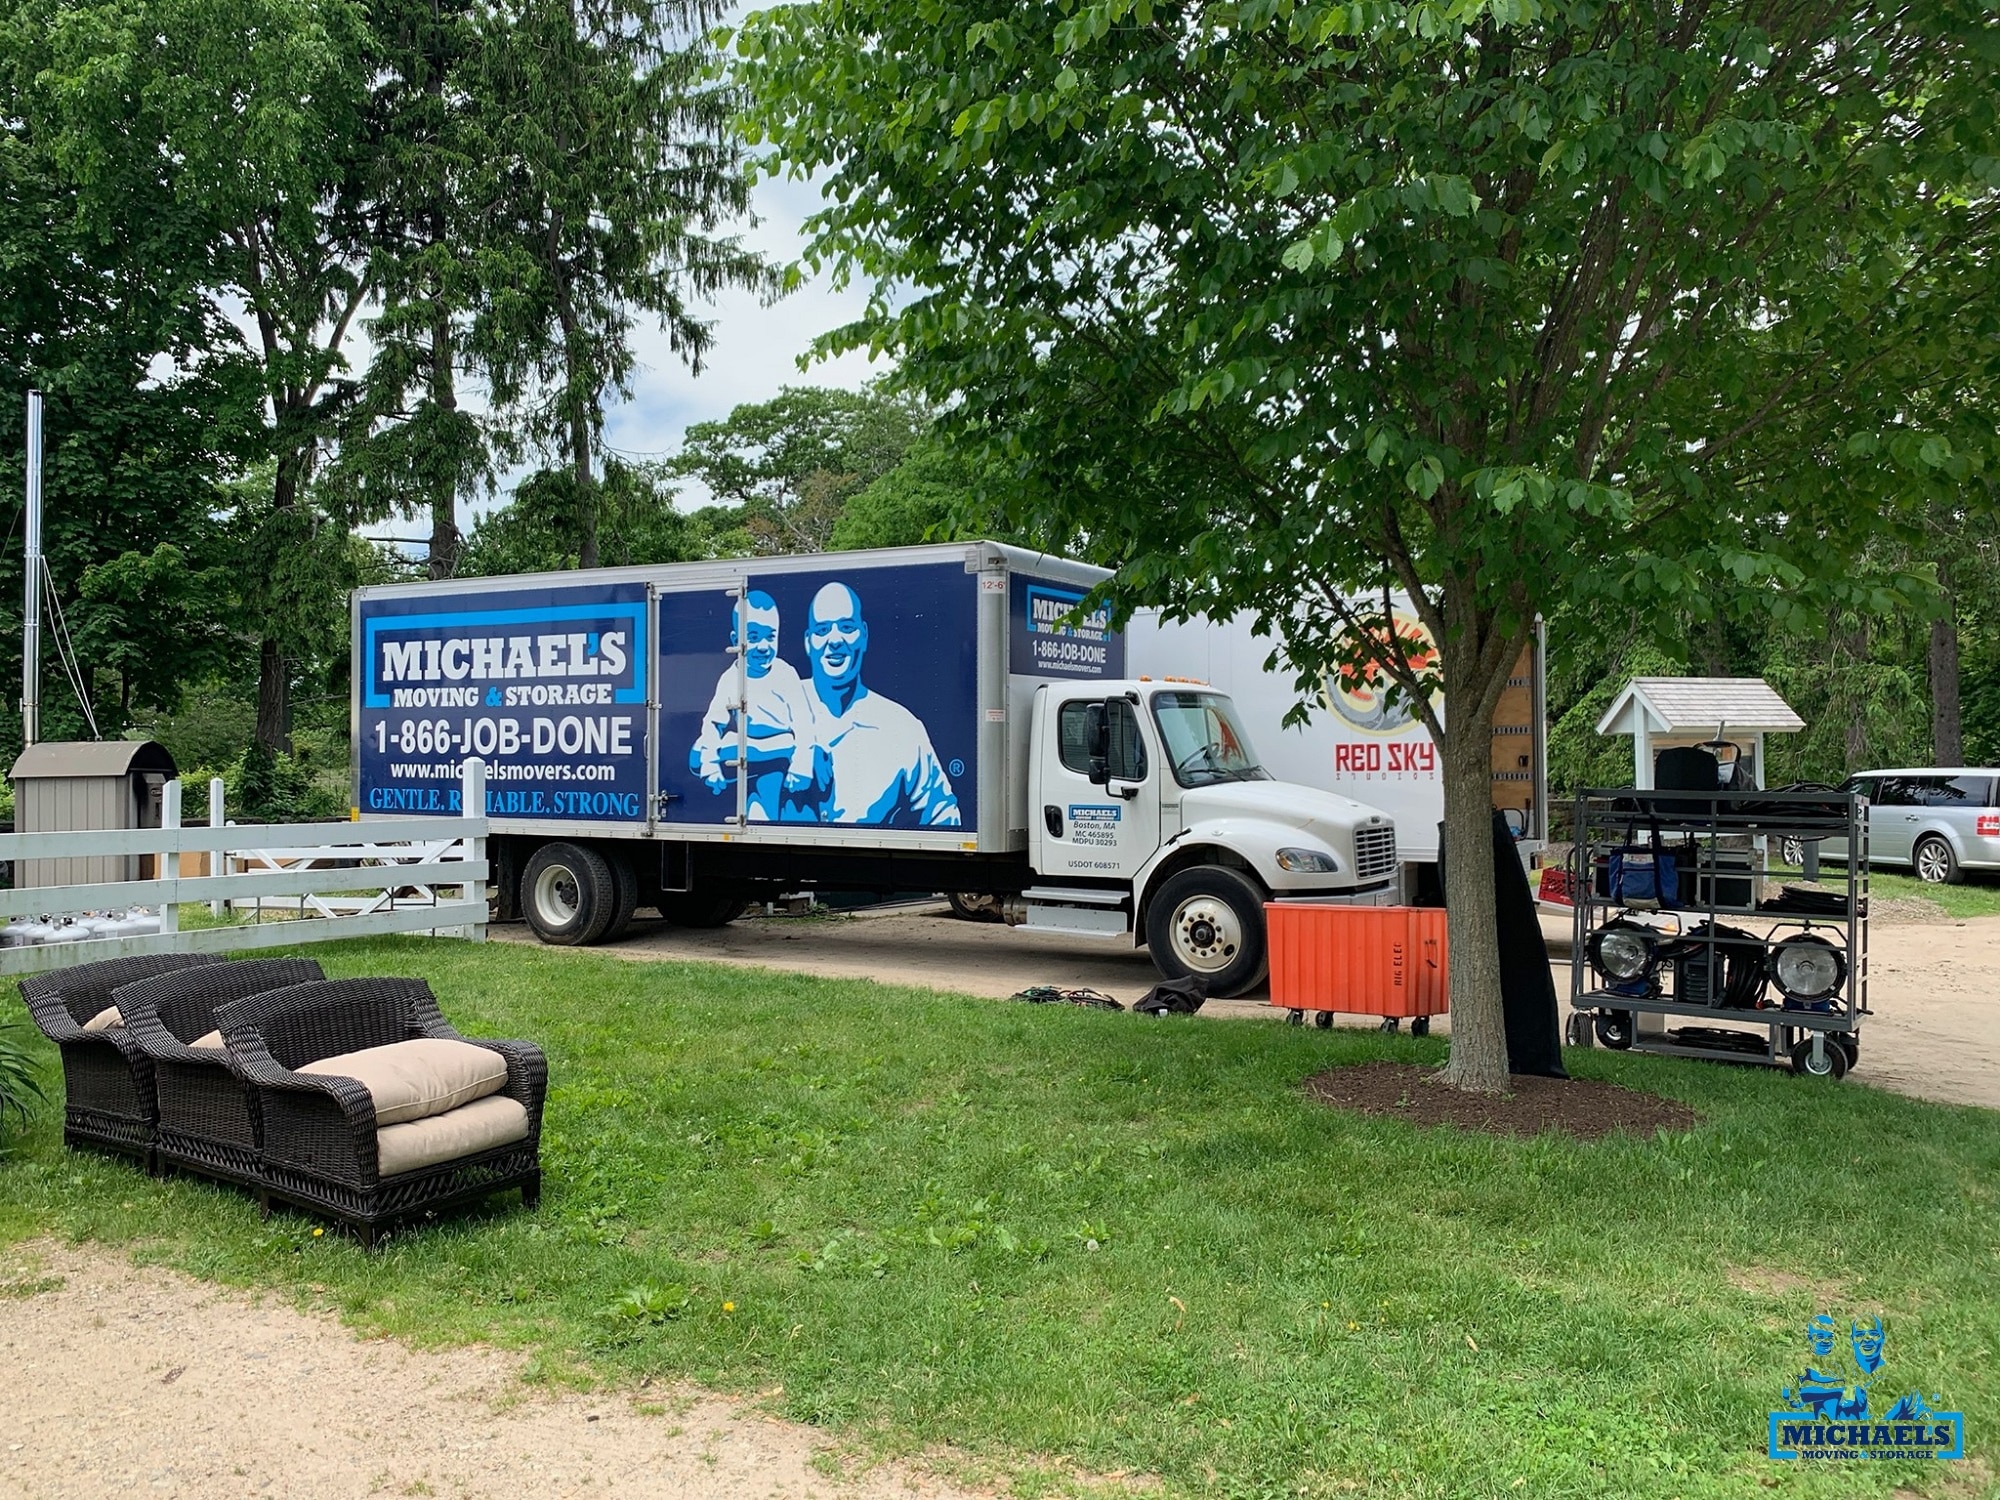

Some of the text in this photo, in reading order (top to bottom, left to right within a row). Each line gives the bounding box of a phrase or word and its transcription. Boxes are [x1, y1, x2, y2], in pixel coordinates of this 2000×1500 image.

[1073, 628, 1103, 641] STORAGE
[382, 631, 626, 681] MICHAEL'S
[1032, 639, 1106, 664] 1-866-JOB-DONE
[1037, 660, 1102, 674] www.michaelsmovers.com
[394, 683, 612, 708] MOVING & STORAGE
[375, 716, 633, 755] 1-866-JOB-DONE
[1336, 743, 1434, 771] RED SKY
[391, 759, 615, 781] www.micelsmovers.com
[369, 787, 640, 817] GENTLE. RIABLE. STRONG
[1073, 820, 1116, 830] Boston, MA
[1075, 830, 1086, 838] MC
[1072, 837, 1095, 845] MDPU
[1068, 860, 1120, 870] USDOT 608571
